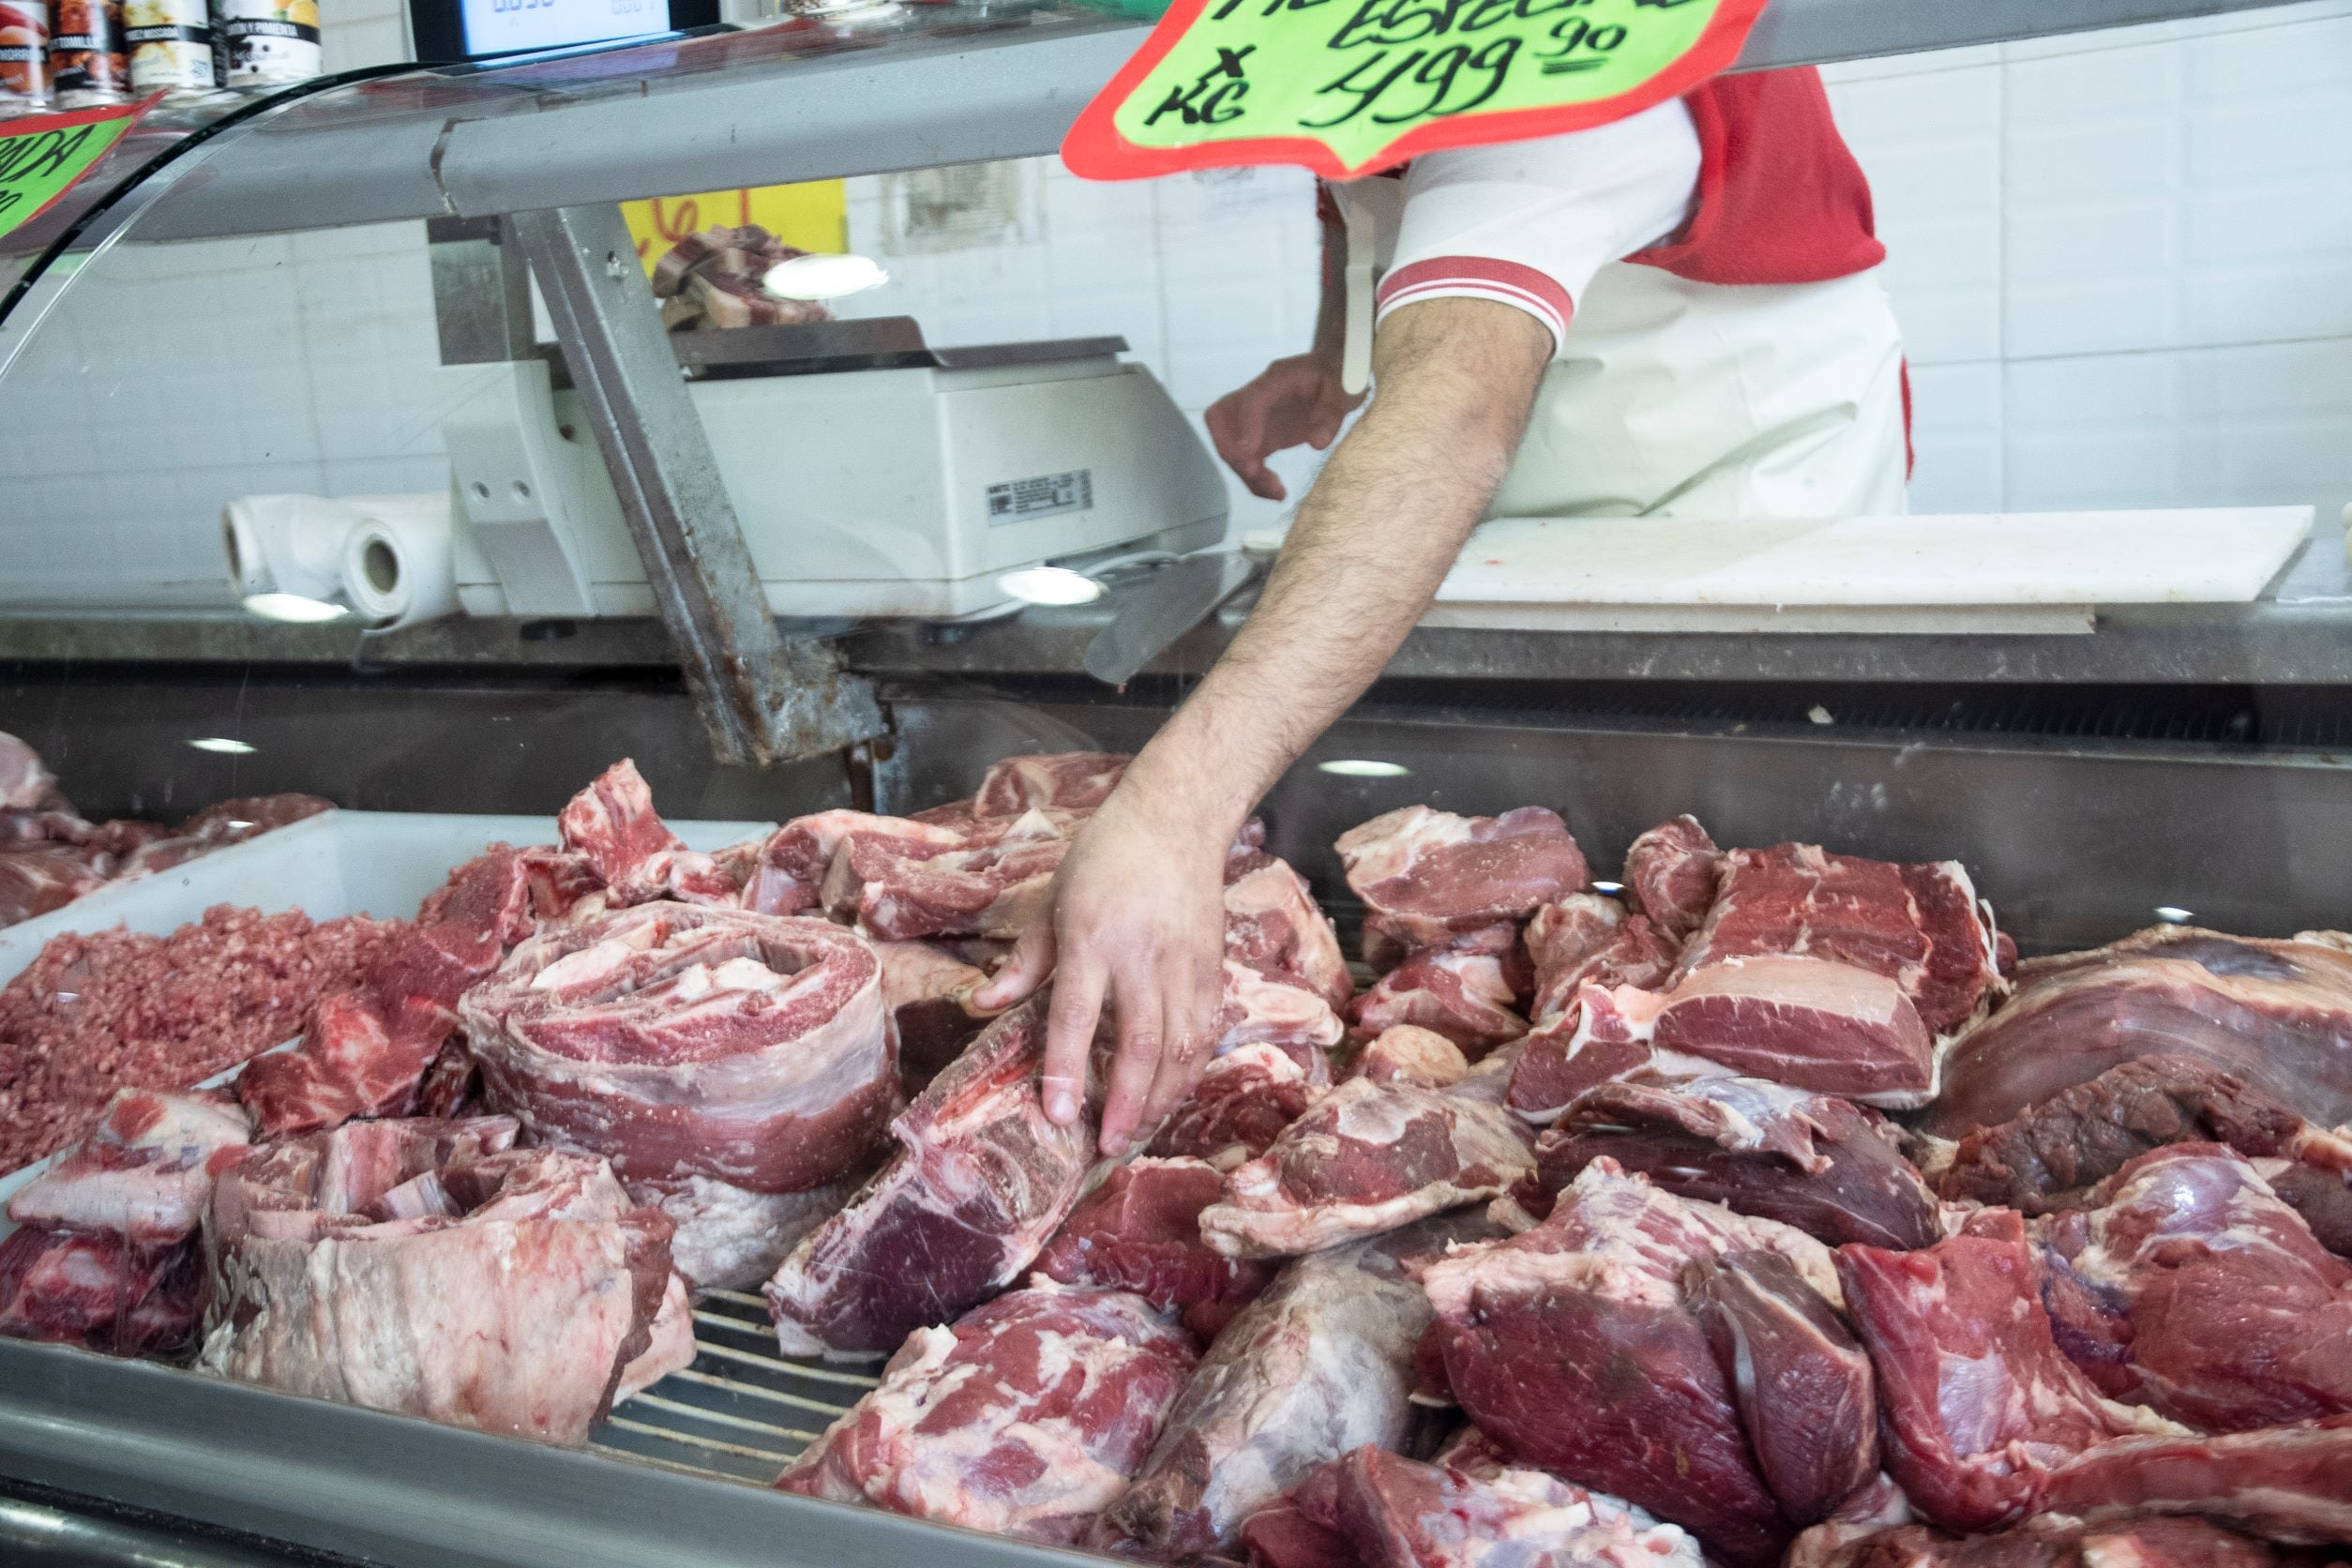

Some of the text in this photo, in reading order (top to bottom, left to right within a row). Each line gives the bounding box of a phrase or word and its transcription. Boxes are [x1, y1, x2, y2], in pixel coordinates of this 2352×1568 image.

[0, 48, 46, 62] MORR
[1143, 79, 1250, 126] KG
[1298, 35, 1524, 128] 499
